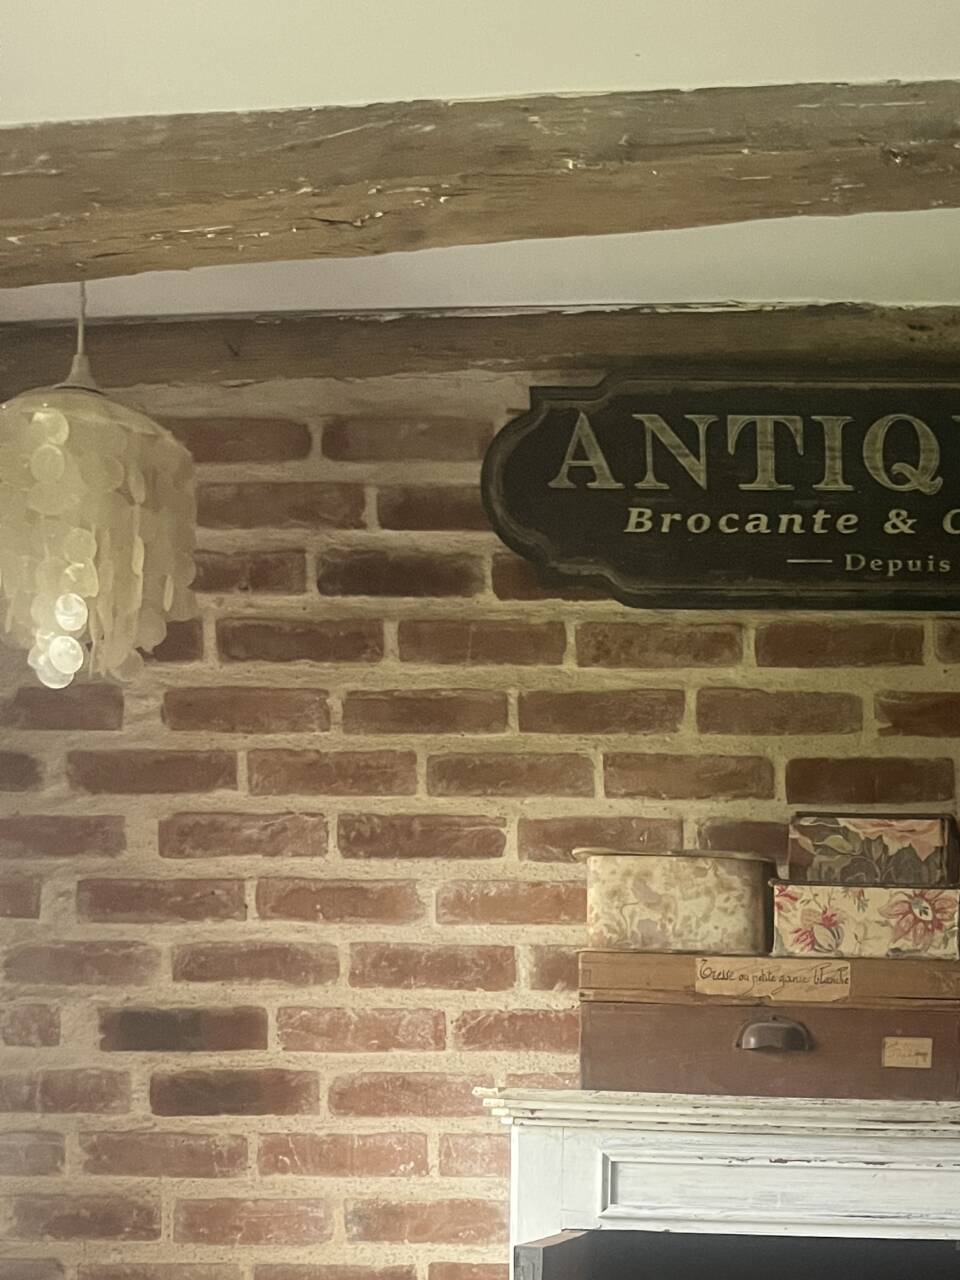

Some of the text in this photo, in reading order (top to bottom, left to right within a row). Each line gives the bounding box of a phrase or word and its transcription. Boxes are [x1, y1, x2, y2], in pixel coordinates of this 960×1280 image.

[624, 506, 860, 535] Brocante
[884, 506, 918, 535] &
[844, 553, 957, 576] Depuis
